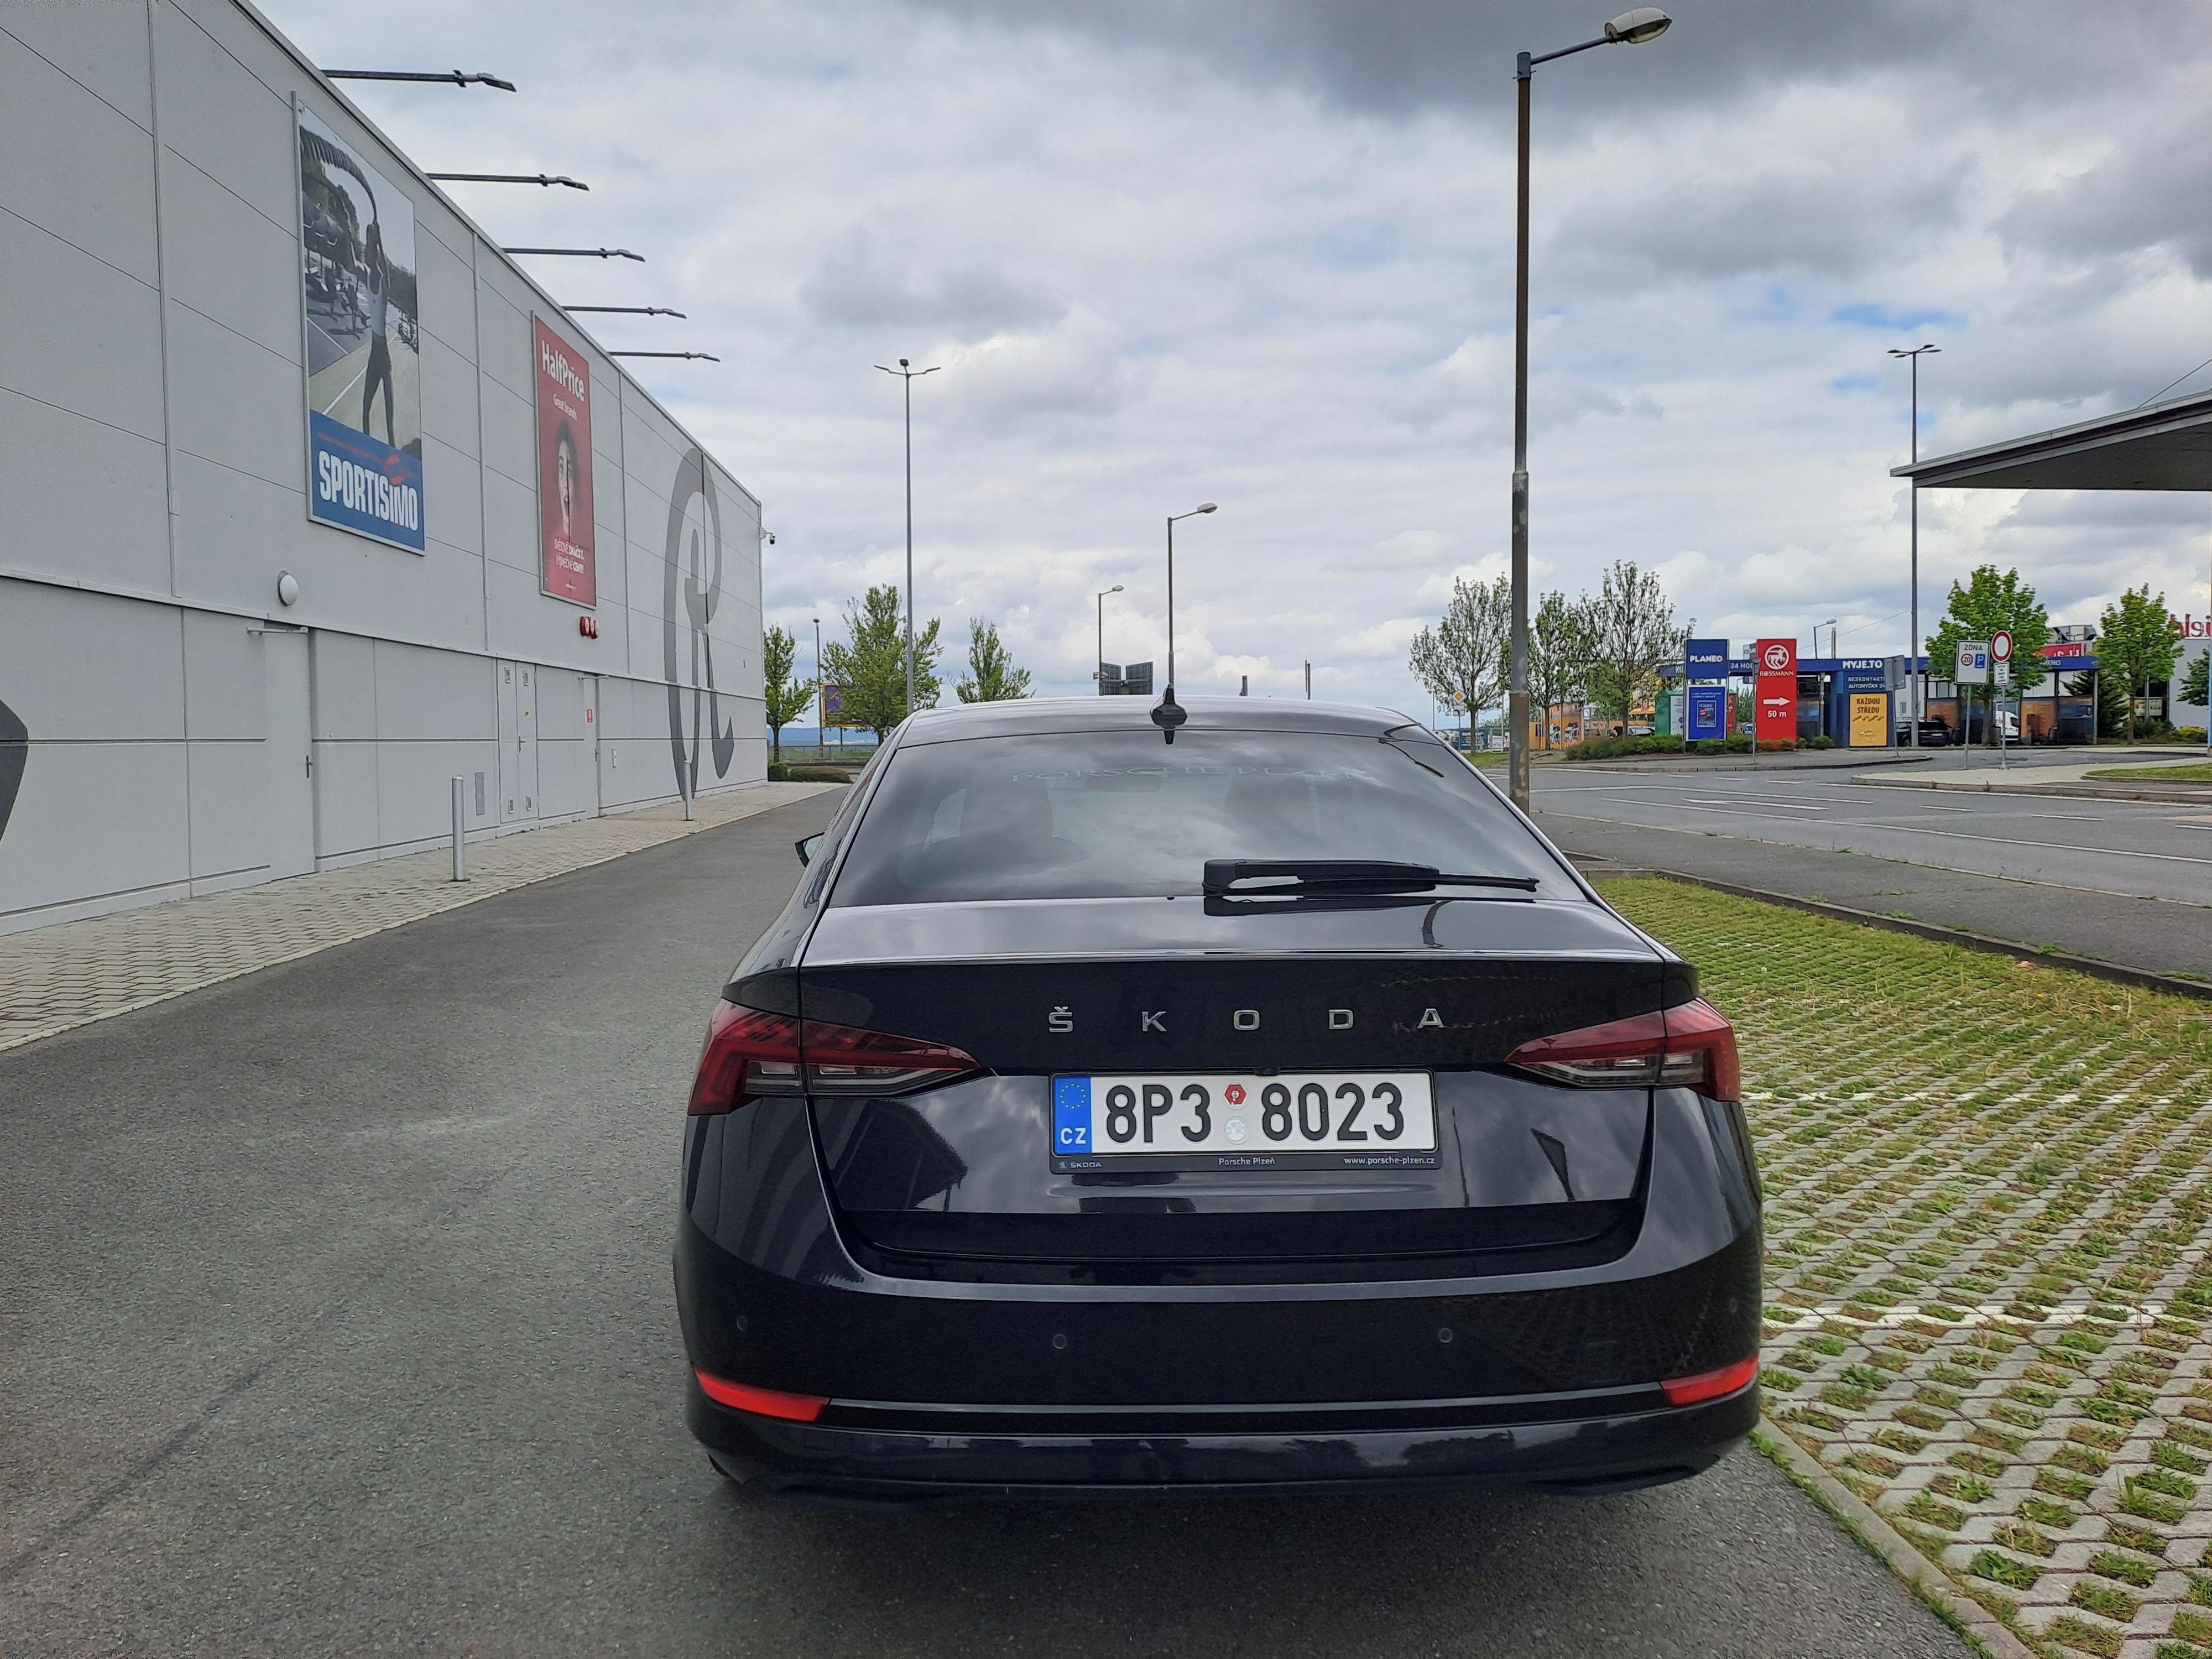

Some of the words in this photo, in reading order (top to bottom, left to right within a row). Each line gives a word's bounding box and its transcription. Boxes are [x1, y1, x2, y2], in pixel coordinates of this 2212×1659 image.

[541, 340, 585, 402] HalfPrice
[319, 450, 419, 531] SPORTISIMO
[1689, 655, 1723, 663] PLANEO
[1842, 660, 1883, 669] MYJE.TO
[1048, 1006, 1444, 1032] ŠKODA
[1106, 1083, 1211, 1144] 8P3
[1261, 1082, 1404, 1141] 8023
[1061, 1127, 1087, 1145] CZ
[1219, 1156, 1251, 1165] Porsche
[1253, 1156, 1275, 1165] Plzeň
[1343, 1156, 1435, 1166] www.porsche-plzen.cz
